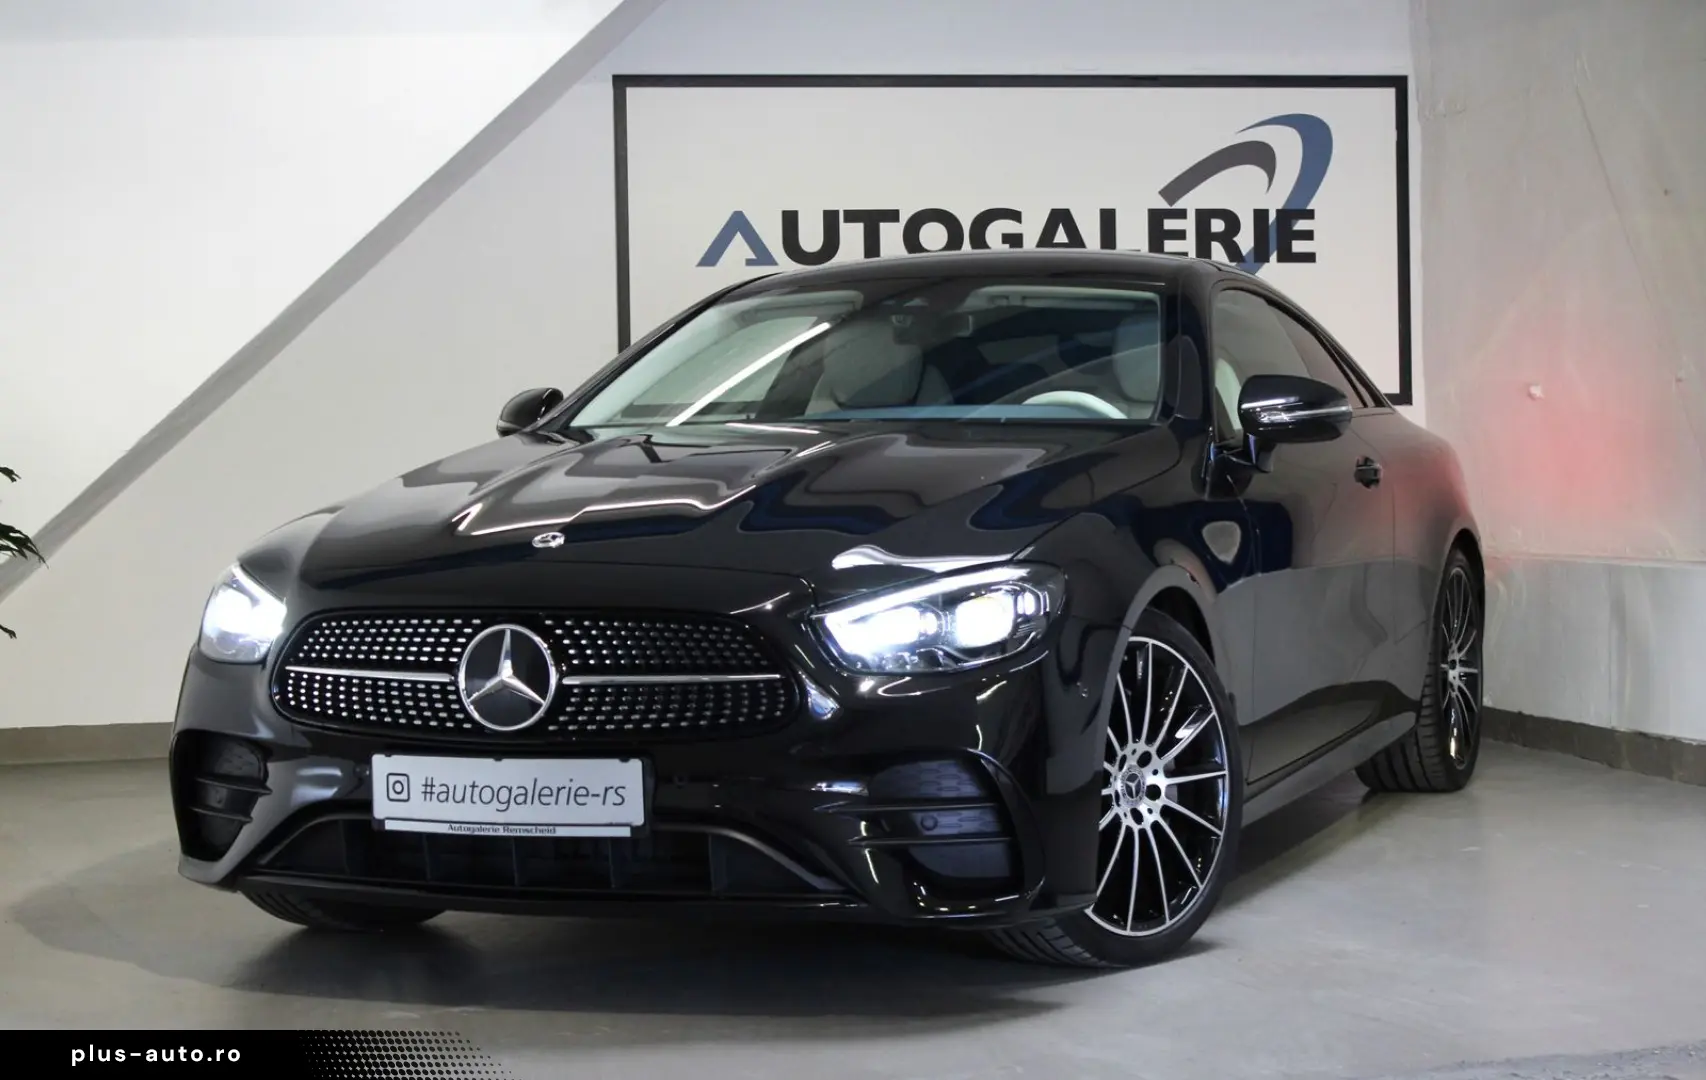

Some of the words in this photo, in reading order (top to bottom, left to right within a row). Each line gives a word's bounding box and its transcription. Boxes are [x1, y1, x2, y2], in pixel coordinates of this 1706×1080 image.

[695, 208, 1317, 267] AUTOGALERIE
[420, 776, 627, 812] #autogalerie-rs
[447, 823, 501, 834] Autogalerie
[502, 825, 557, 835] Remscheid
